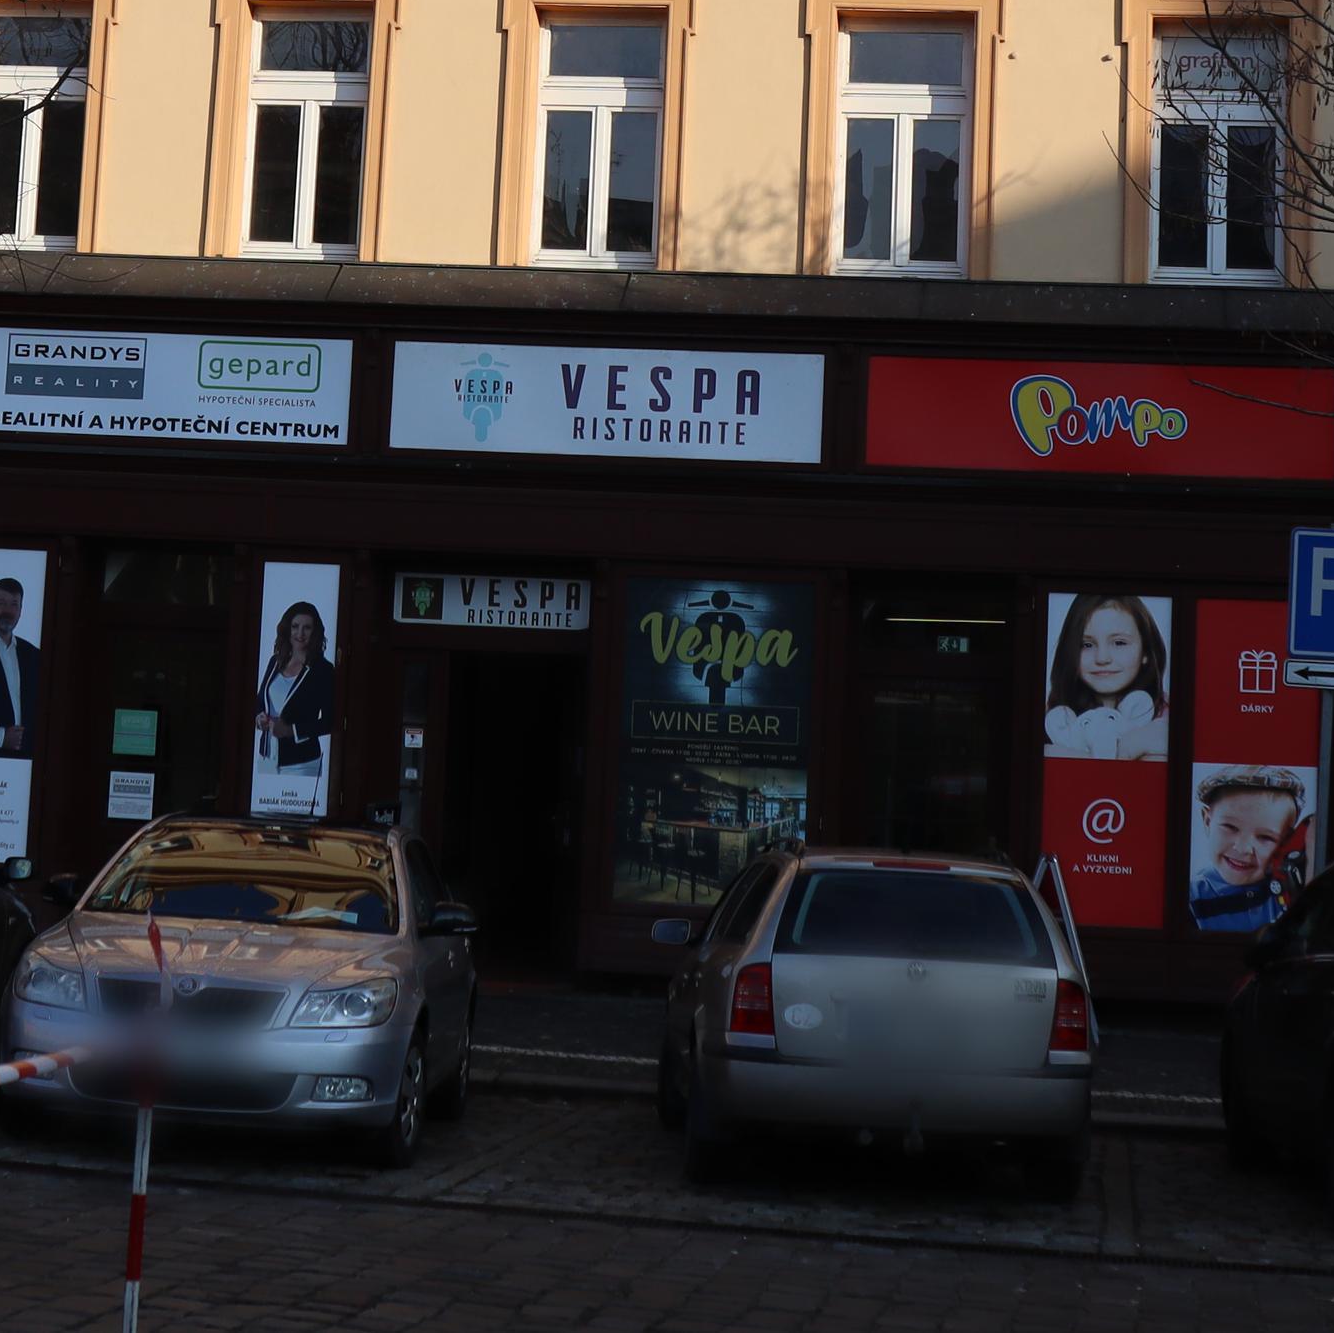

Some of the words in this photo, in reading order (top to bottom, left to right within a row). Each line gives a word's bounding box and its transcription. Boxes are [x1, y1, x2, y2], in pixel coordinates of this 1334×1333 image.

[14, 343, 140, 361] GRANDYS
[208, 353, 312, 381] gepard
[12, 375, 139, 389] REALITY
[454, 378, 513, 395] VESPA
[561, 363, 761, 415] VESPA
[198, 394, 255, 406] HYPOTEČNÍ
[257, 397, 316, 408] SPECIALISTA
[1009, 373, 1188, 457] Pompo
[88, 415, 103, 429] A
[109, 414, 230, 434] HYPOTEČNÍ
[236, 421, 339, 439] CENTRUM
[573, 416, 747, 446] RISTORANTE
[460, 577, 581, 611] VESPA
[467, 609, 573, 628] RISTORANTE
[639, 611, 798, 683] Vespa
[1240, 703, 1274, 714] DÁRKY
[649, 710, 719, 733] WINE
[728, 713, 780, 736] BAR
[1087, 853, 1119, 863] KLIKNI
[1072, 864, 1080, 873] A
[1082, 864, 1132, 875] VYZVEDNI
